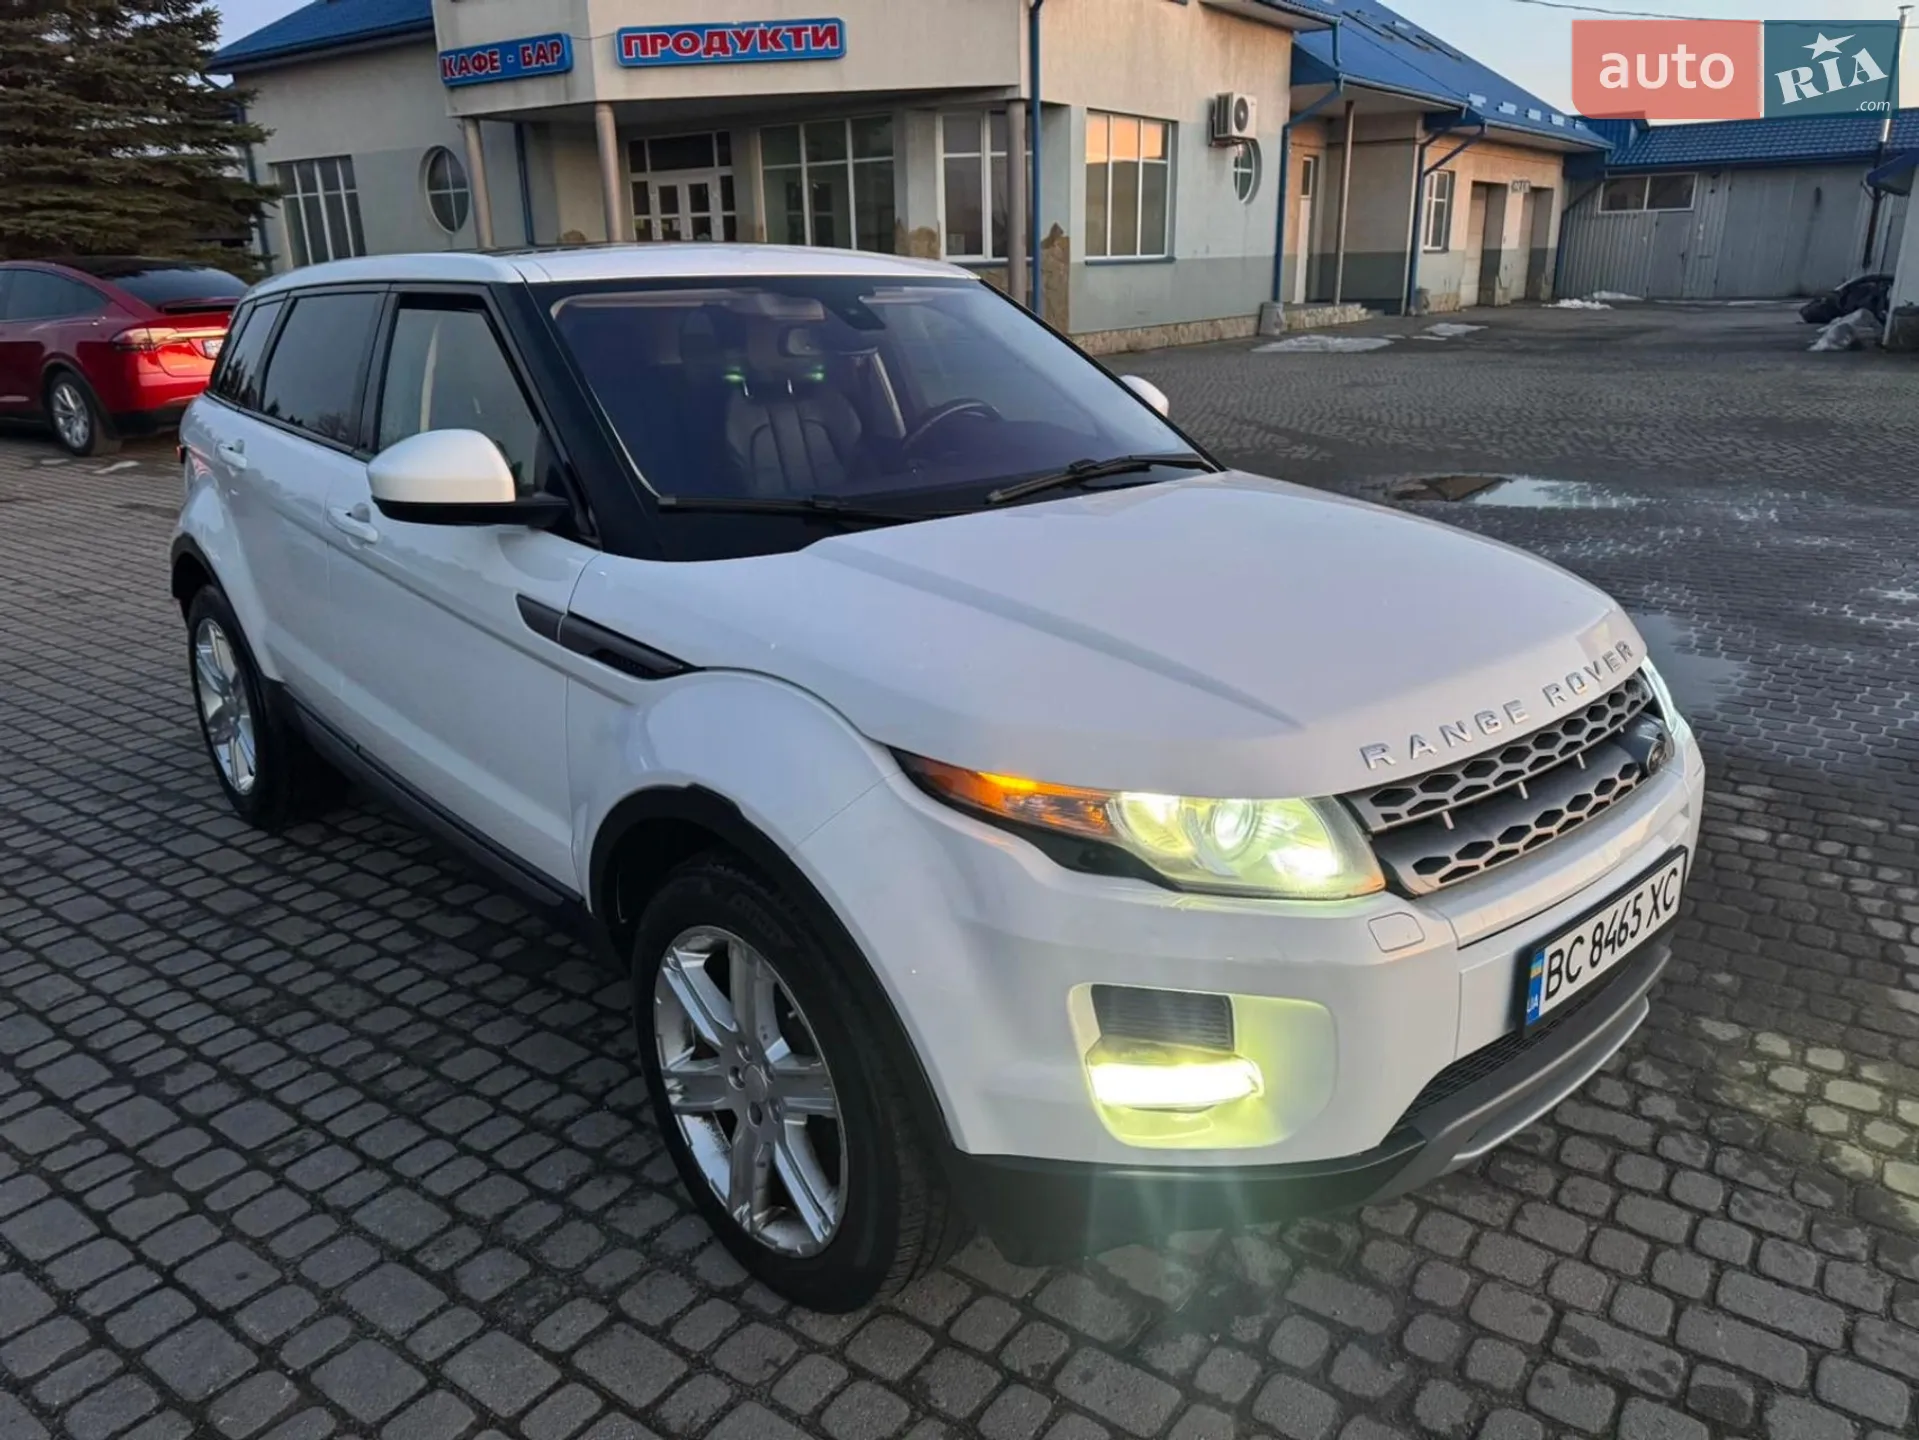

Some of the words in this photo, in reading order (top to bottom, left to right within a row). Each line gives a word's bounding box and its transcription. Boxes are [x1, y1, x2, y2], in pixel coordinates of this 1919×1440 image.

[441, 49, 501, 79] КАФЕ
[519, 40, 562, 69] БАР
[622, 23, 841, 59] ПРОДУКТИ
[1359, 699, 1530, 770] RANGE
[1542, 640, 1634, 708] ROVER
[1545, 935, 1584, 1001] BC
[1589, 890, 1644, 968] 8465
[1646, 867, 1678, 929] XC
